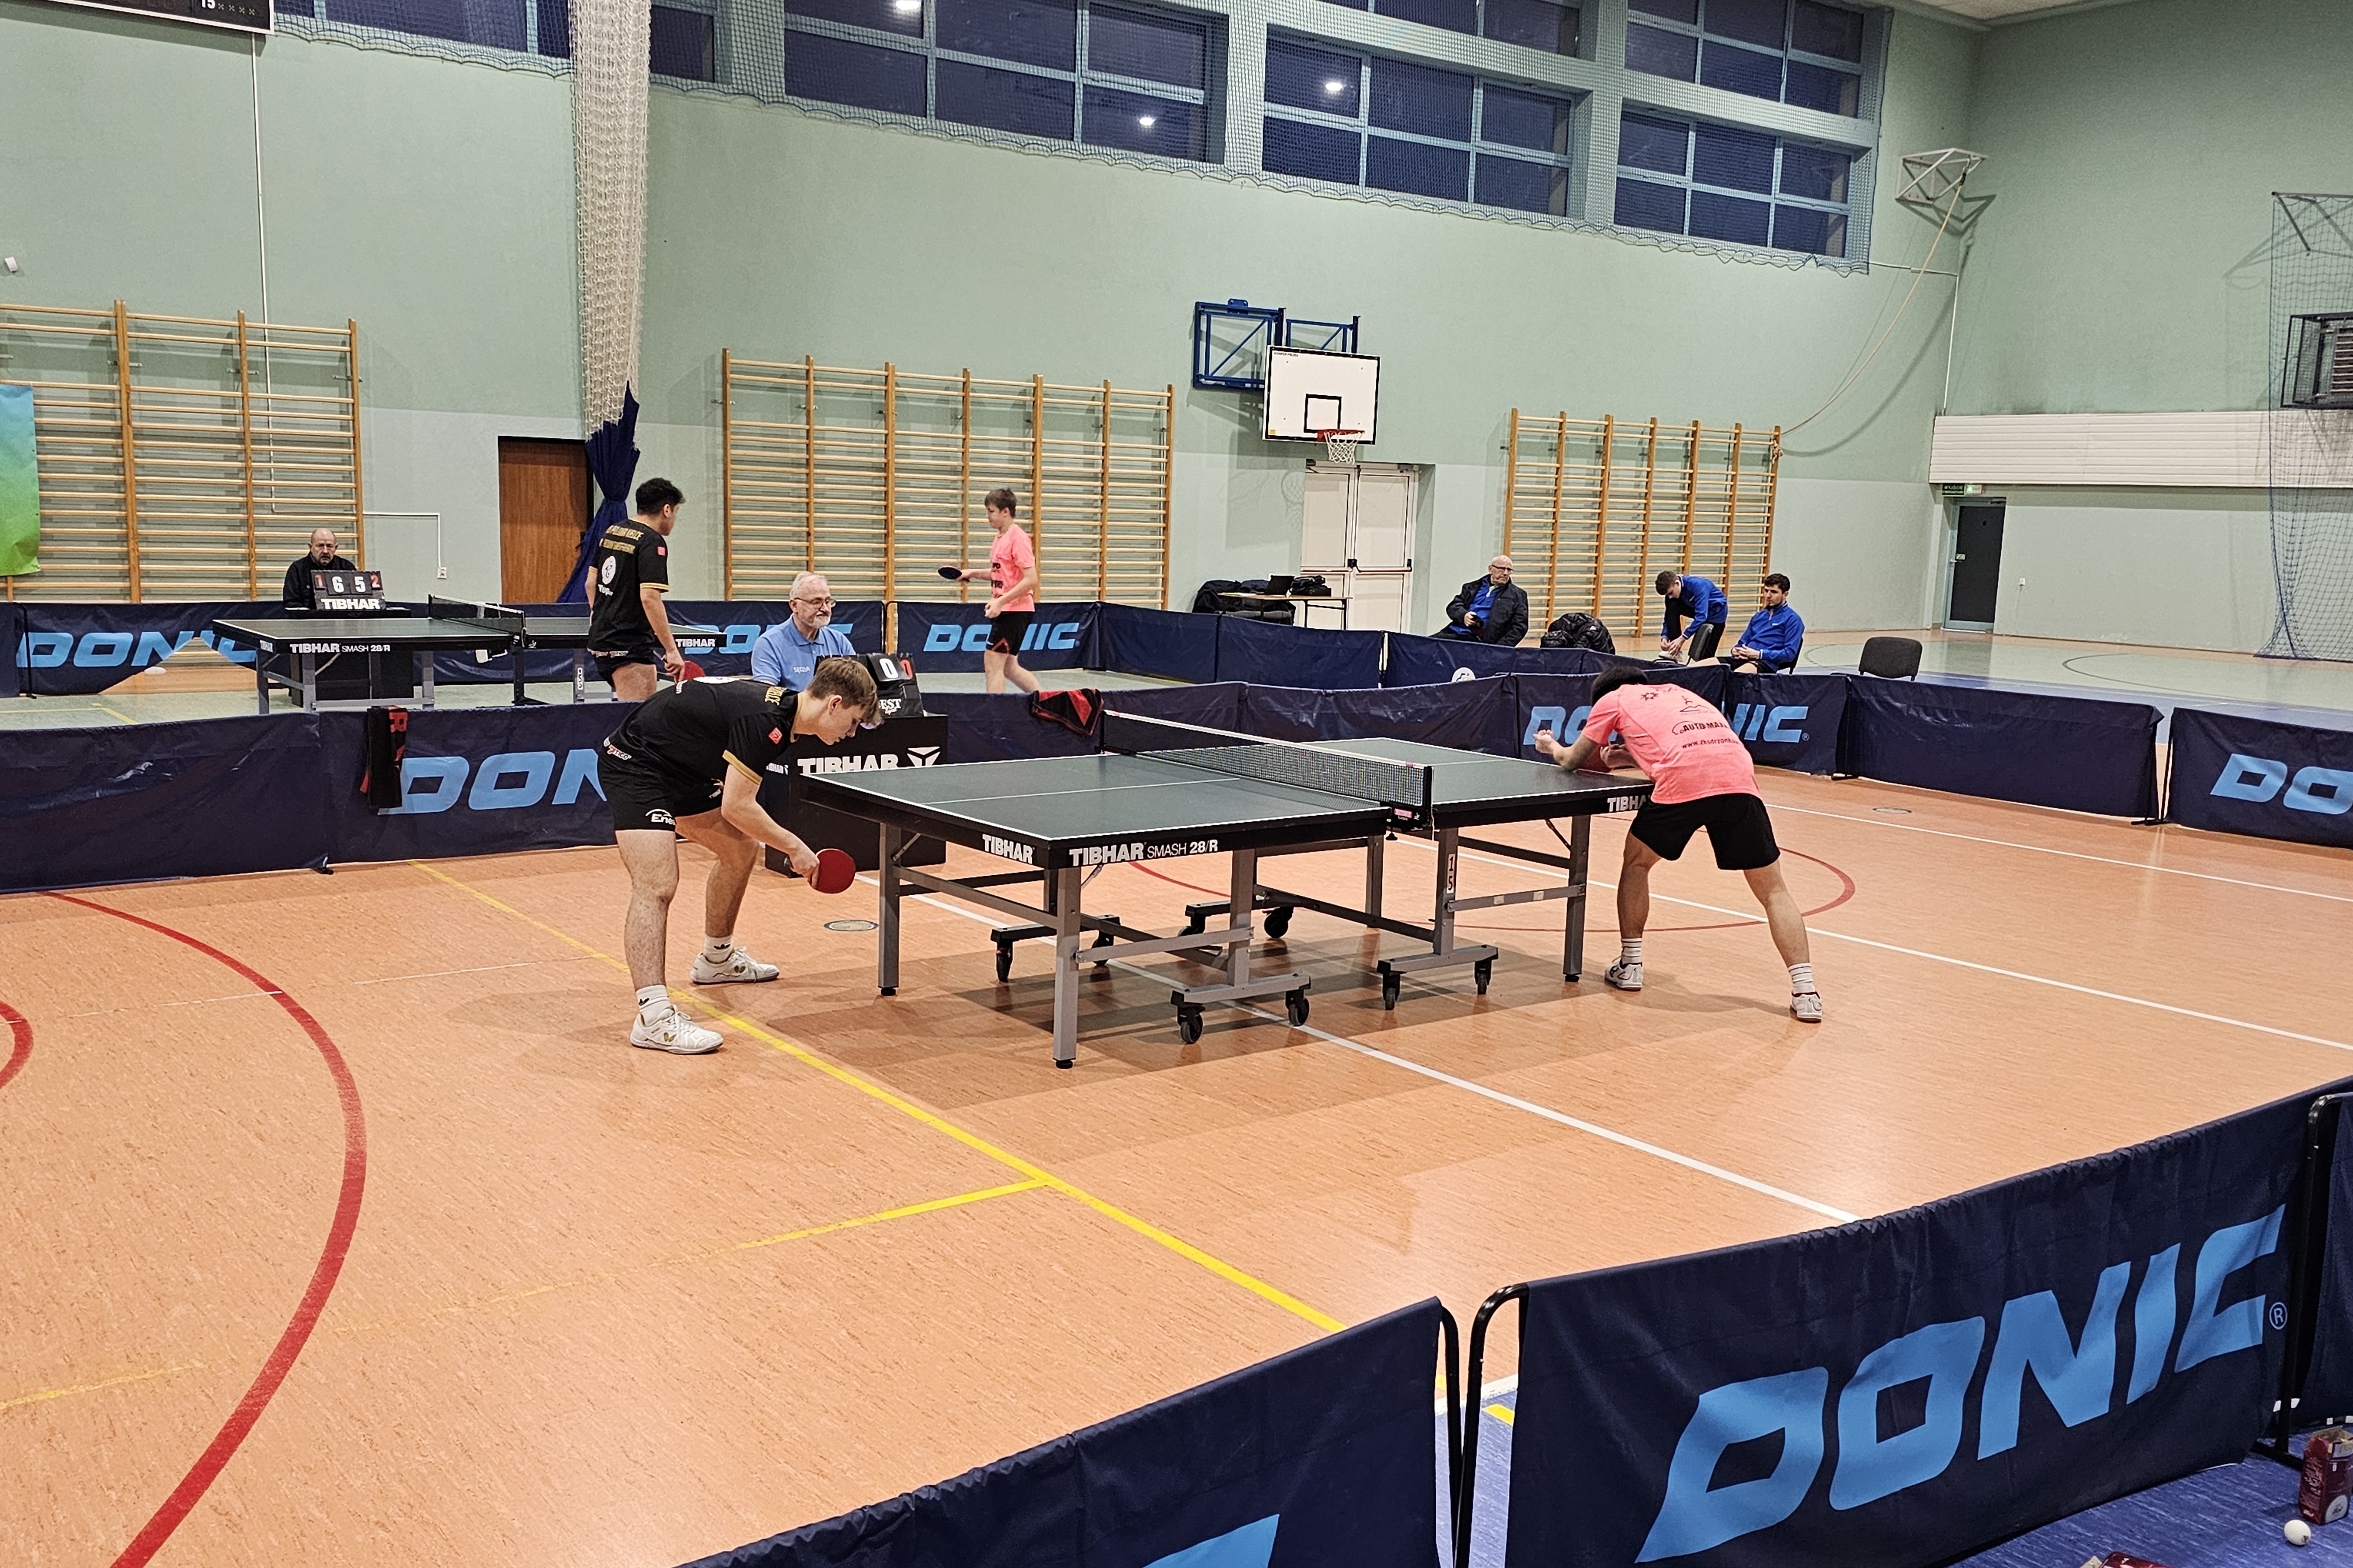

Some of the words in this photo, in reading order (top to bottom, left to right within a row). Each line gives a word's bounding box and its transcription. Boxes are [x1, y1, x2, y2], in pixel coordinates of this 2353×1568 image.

[332, 576, 344, 593] 6
[355, 576, 366, 593] 5
[371, 575, 381, 588] 2
[321, 599, 380, 609] TIBHAR
[676, 639, 715, 647] TIBHAR
[924, 623, 1079, 652] DOIC
[290, 643, 340, 653] TIBHAR
[879, 658, 898, 679] 0
[878, 698, 902, 709] EST
[797, 754, 899, 775] TIBHAR
[1607, 795, 1650, 813] TIBHA
[982, 835, 1034, 864] TIBHAR
[1069, 843, 1144, 866] TIBHAR
[1147, 843, 1187, 859] SMASH
[1189, 839, 1218, 853] 28/R
[1636, 1203, 2285, 1563] DONIC
